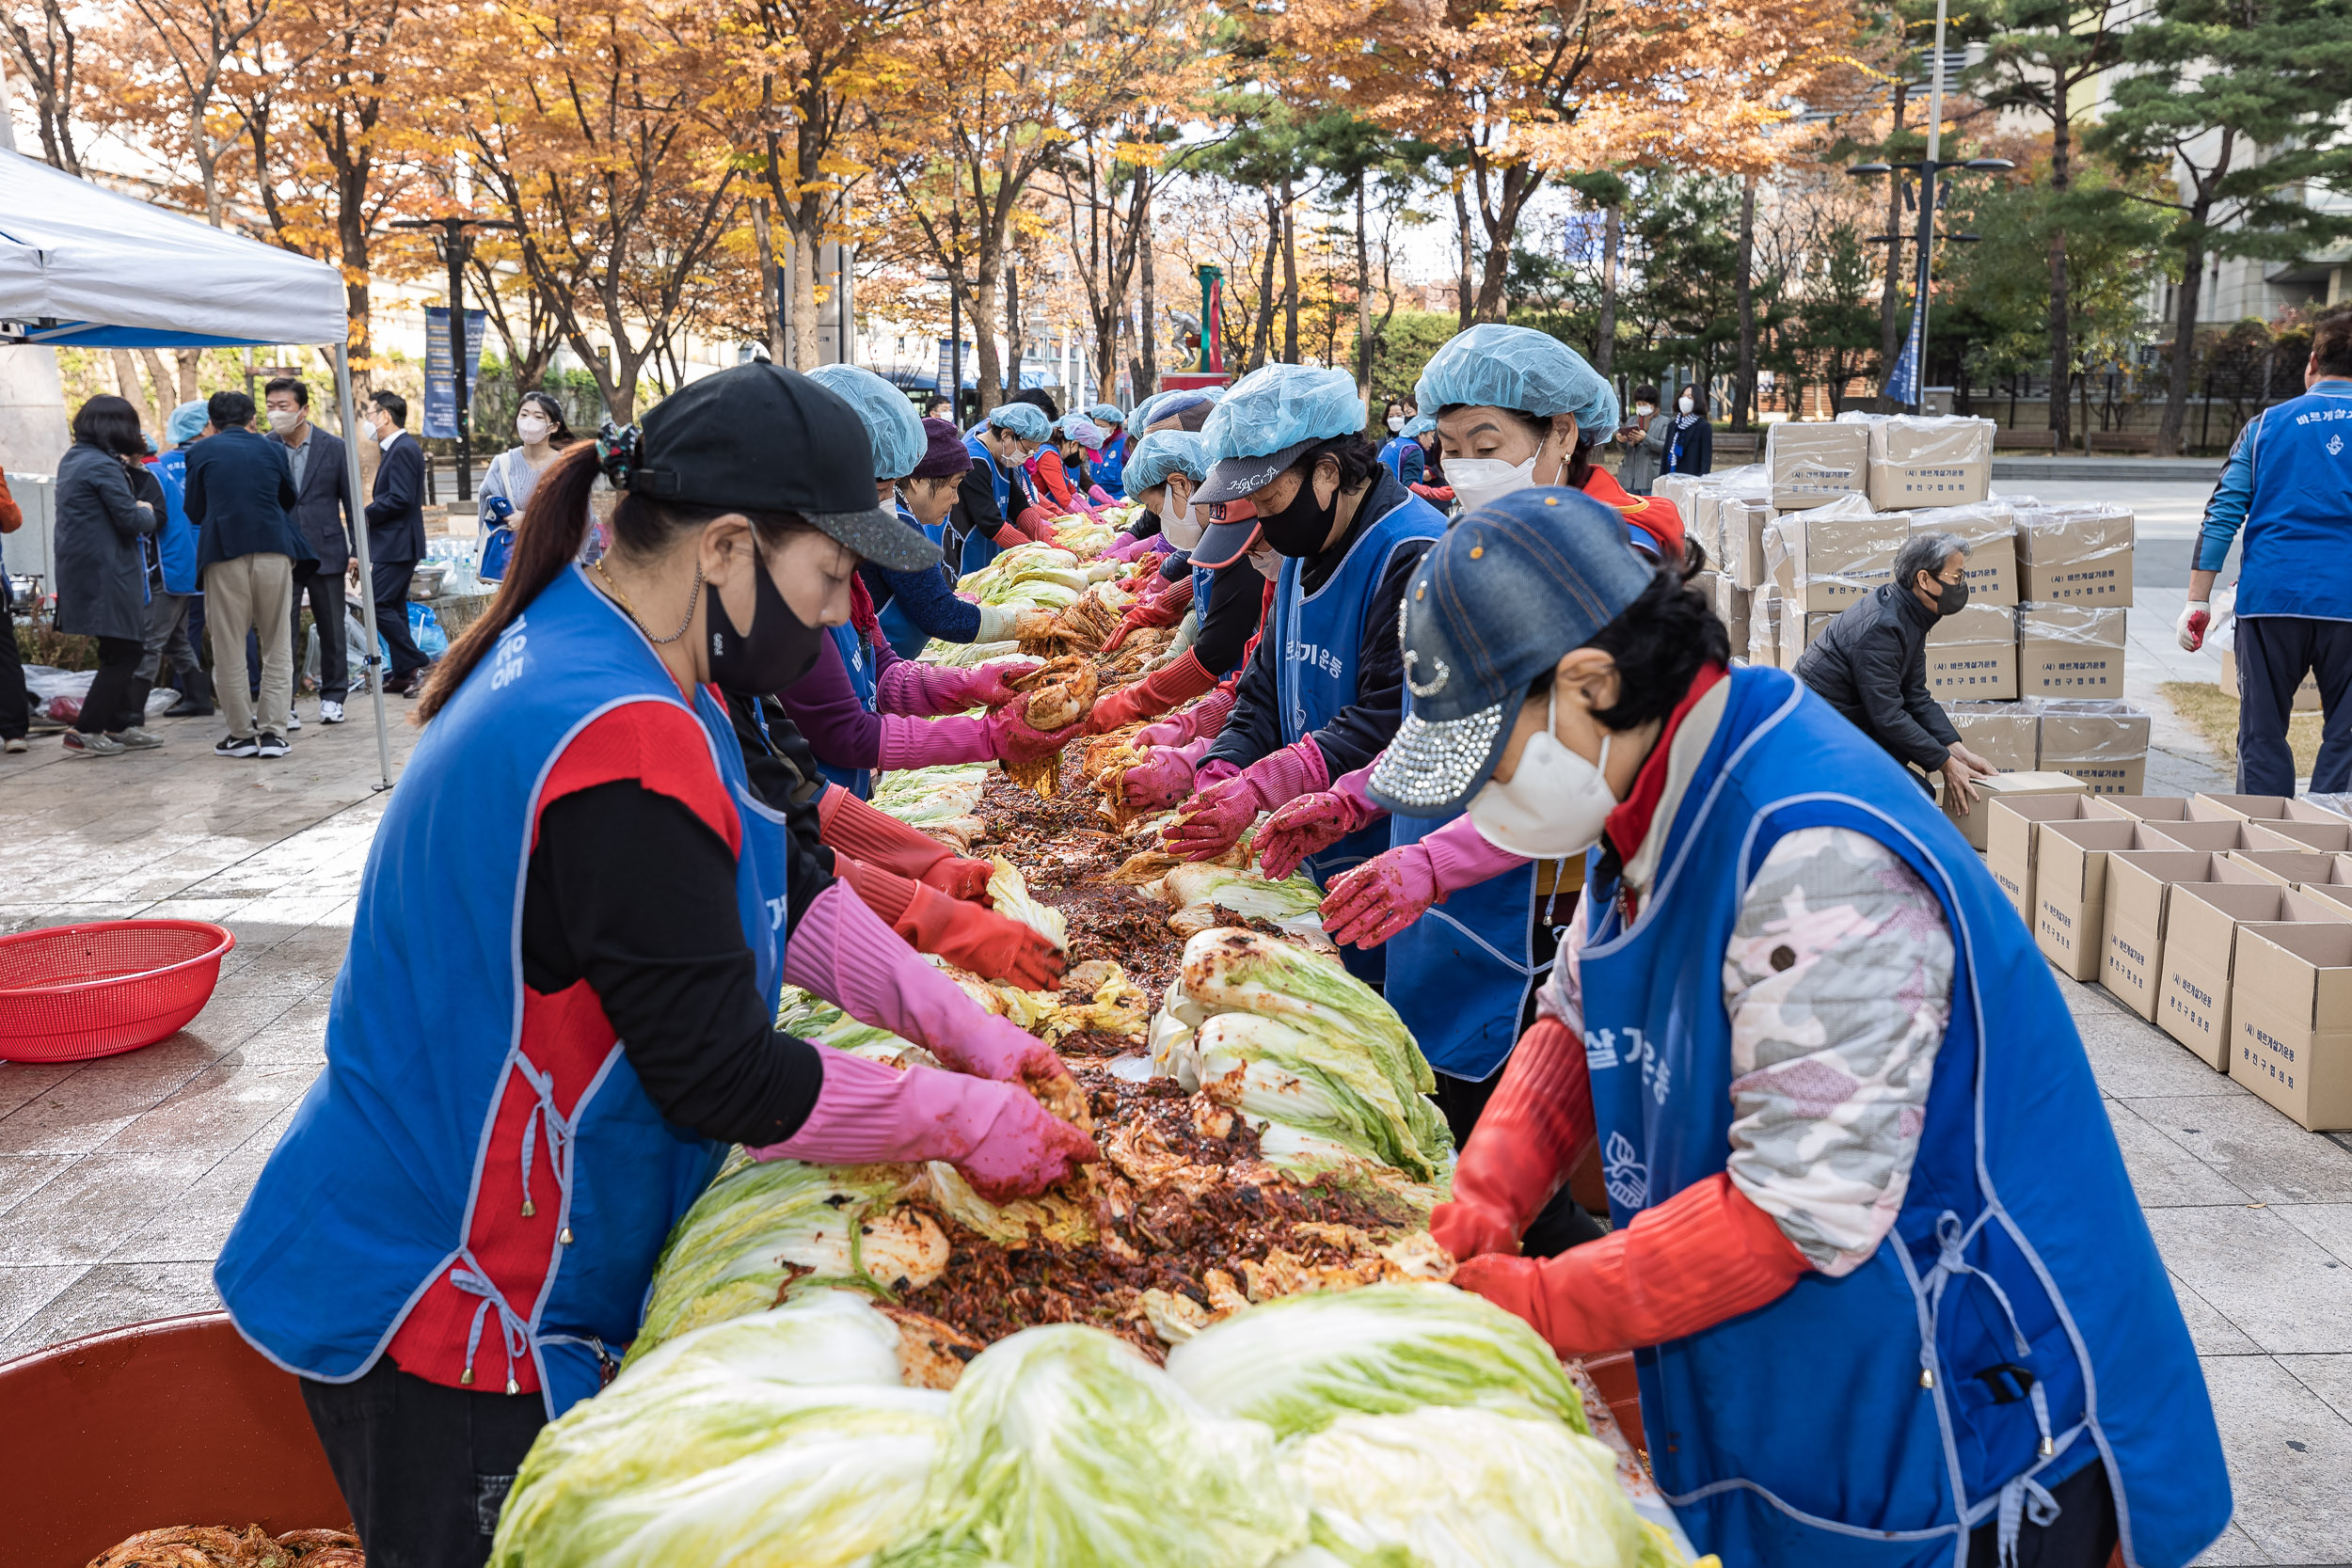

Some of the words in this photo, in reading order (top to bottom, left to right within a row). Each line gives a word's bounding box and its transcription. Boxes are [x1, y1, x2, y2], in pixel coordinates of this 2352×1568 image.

[1791, 470, 1804, 479] (사)
[2050, 575, 2064, 583] (사)
[2067, 569, 2115, 581] 바르게살기운동
[1933, 662, 1947, 671] (사)
[1950, 660, 1997, 671] 바르게살기운동
[2058, 661, 2106, 671] 바르게살기운동
[2075, 769, 2125, 778] 바르게살기운동
[2049, 904, 2072, 928] 바르게살기운동
[2110, 933, 2119, 946] (사)
[2119, 940, 2145, 966] 바르게살기운동
[2172, 972, 2181, 986] (사)
[2182, 978, 2212, 1008] 바르게살기운동
[2244, 1022, 2255, 1037] (사)
[2256, 1029, 2295, 1062] 바르게살기운동
